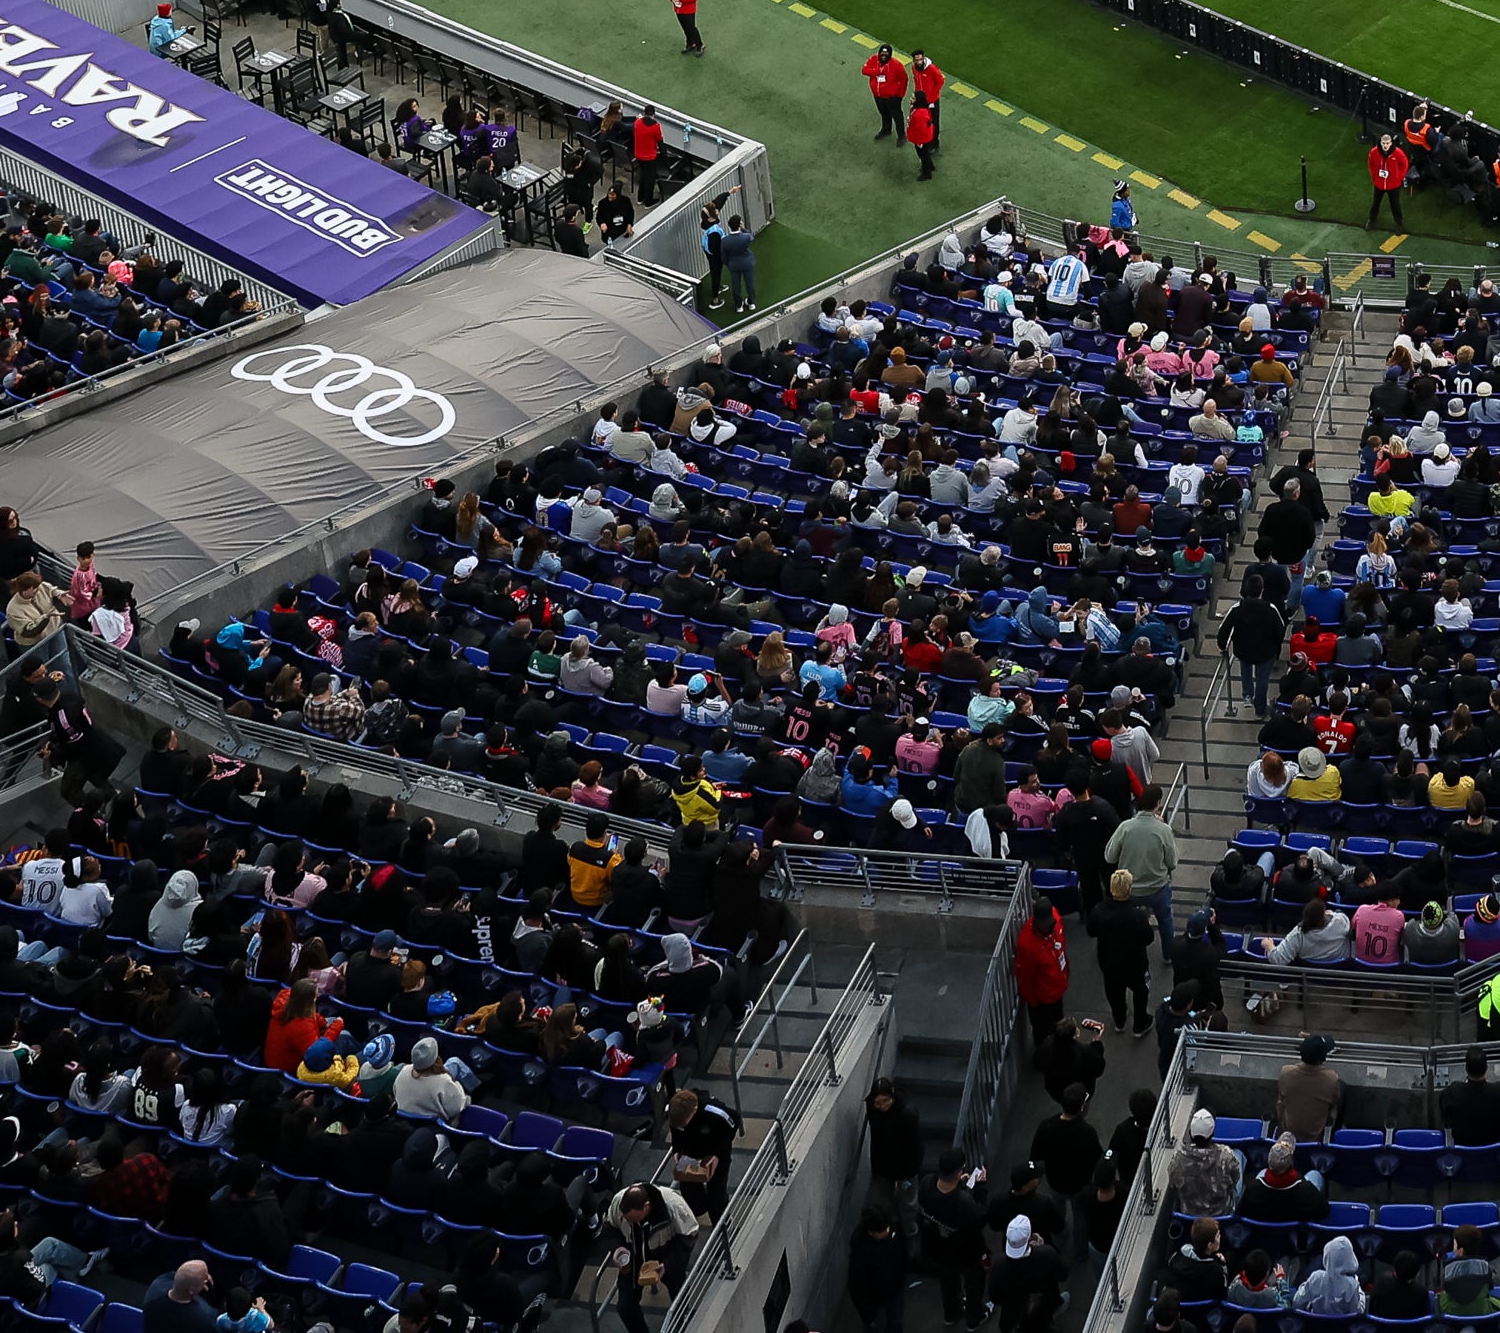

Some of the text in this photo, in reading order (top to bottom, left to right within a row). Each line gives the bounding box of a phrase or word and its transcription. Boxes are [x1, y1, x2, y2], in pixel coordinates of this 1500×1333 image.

[491, 137, 507, 149] 20
[1054, 264, 1071, 283] 10
[1453, 377, 1473, 394] 10
[1324, 740, 1338, 754] 7
[34, 866, 59, 875] MESSI
[21, 879, 57, 904] 10
[1364, 931, 1388, 959] 10
[134, 1089, 159, 1122] 89
